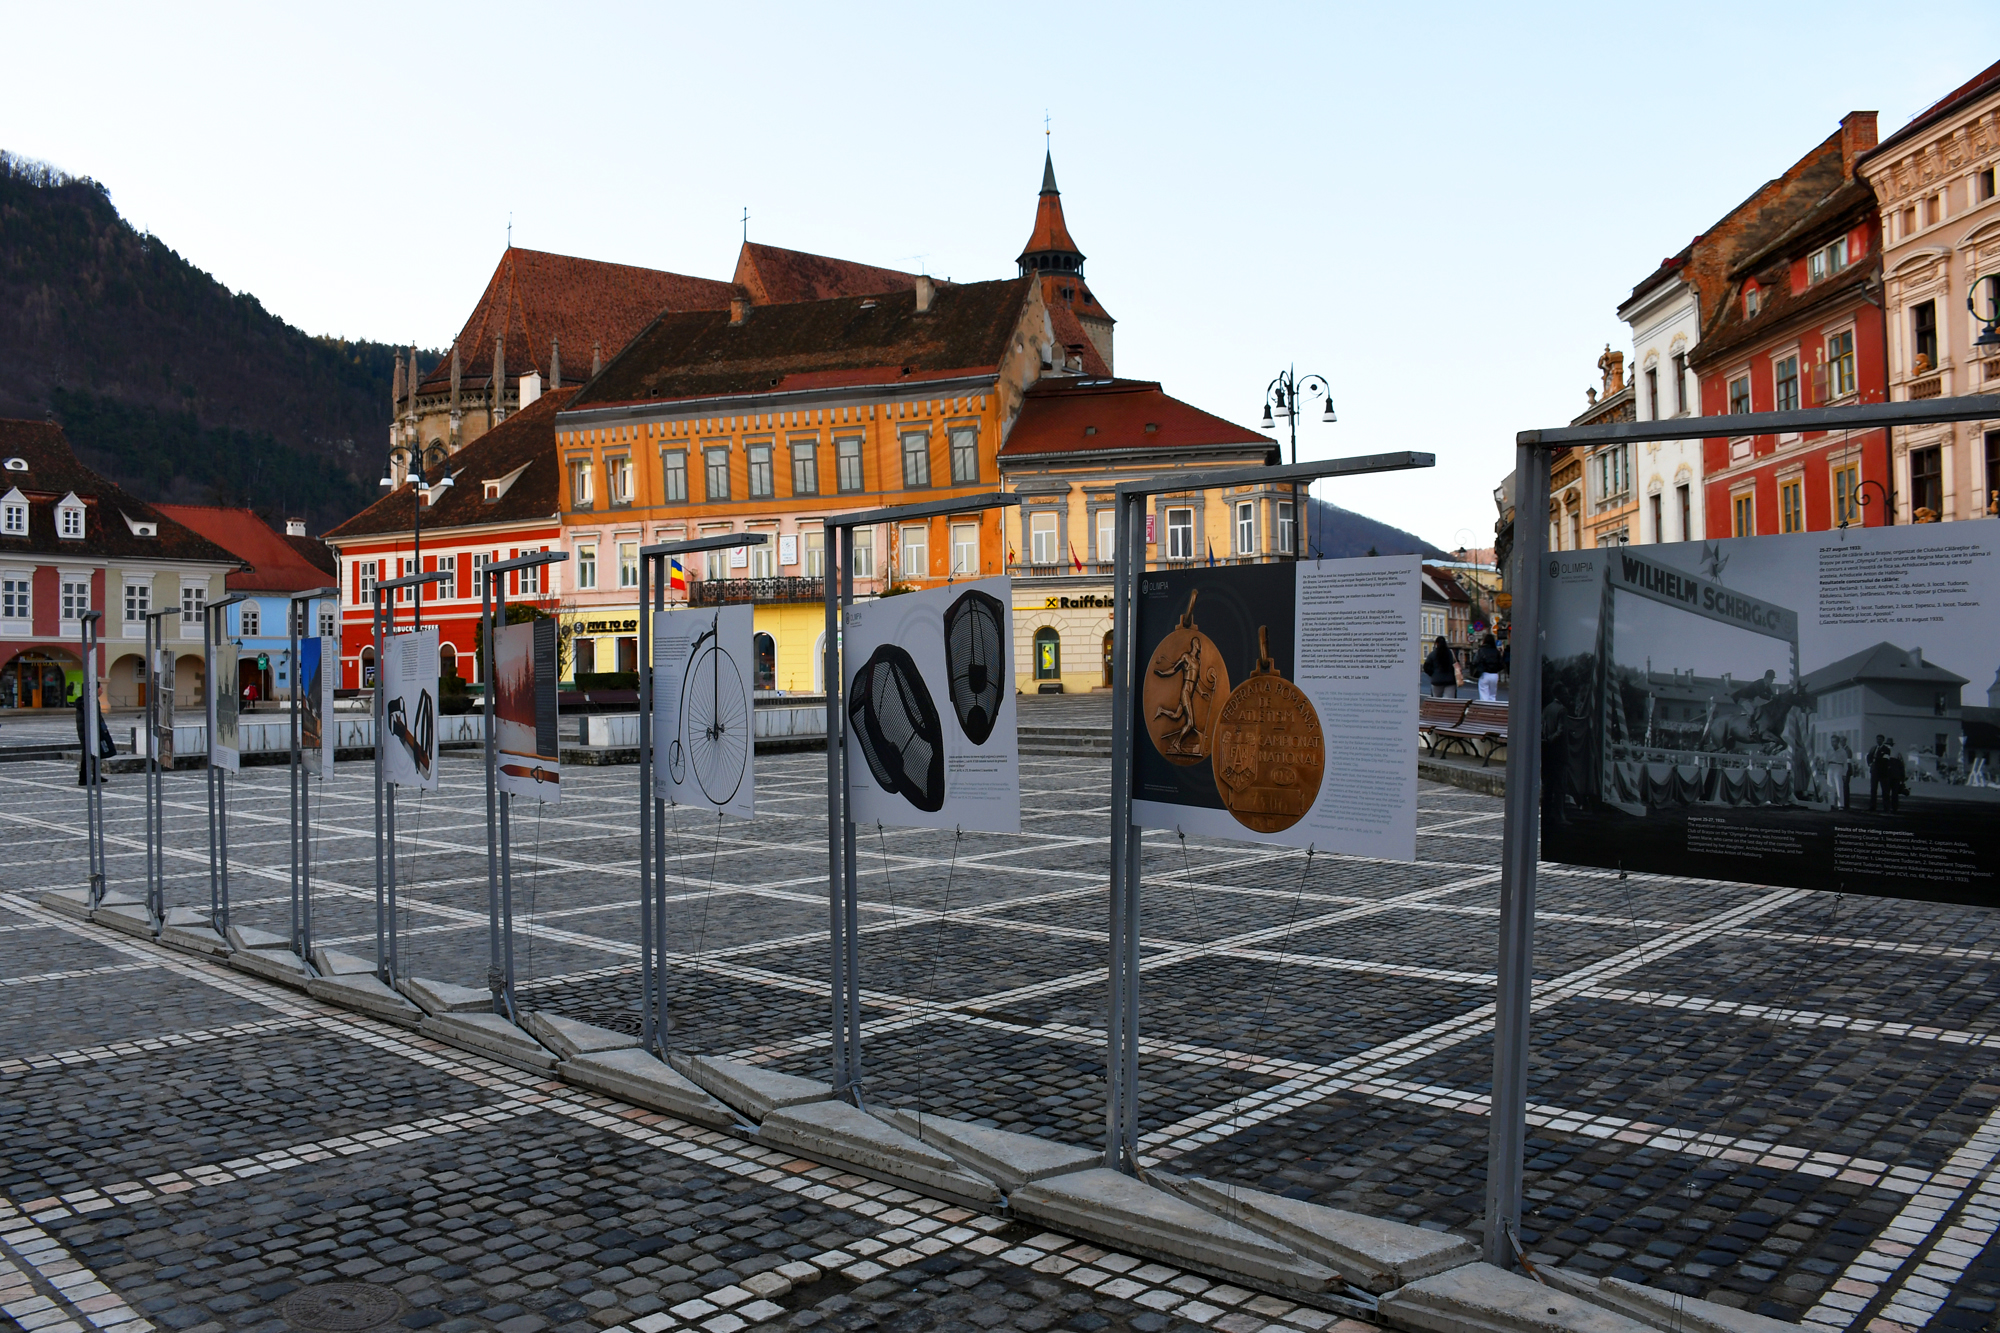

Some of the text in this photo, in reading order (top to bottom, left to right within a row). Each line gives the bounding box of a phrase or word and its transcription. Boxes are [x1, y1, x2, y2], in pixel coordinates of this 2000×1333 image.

[1562, 562, 1593, 573] OLIMPIA
[1621, 555, 1698, 605] WILHELM
[1703, 586, 1761, 626] SCHERG
[1259, 697, 1271, 708] DE
[1238, 710, 1294, 722] ATLETISM
[1259, 735, 1320, 749] CAMPIONAT
[1258, 751, 1318, 766] NATIONAL
